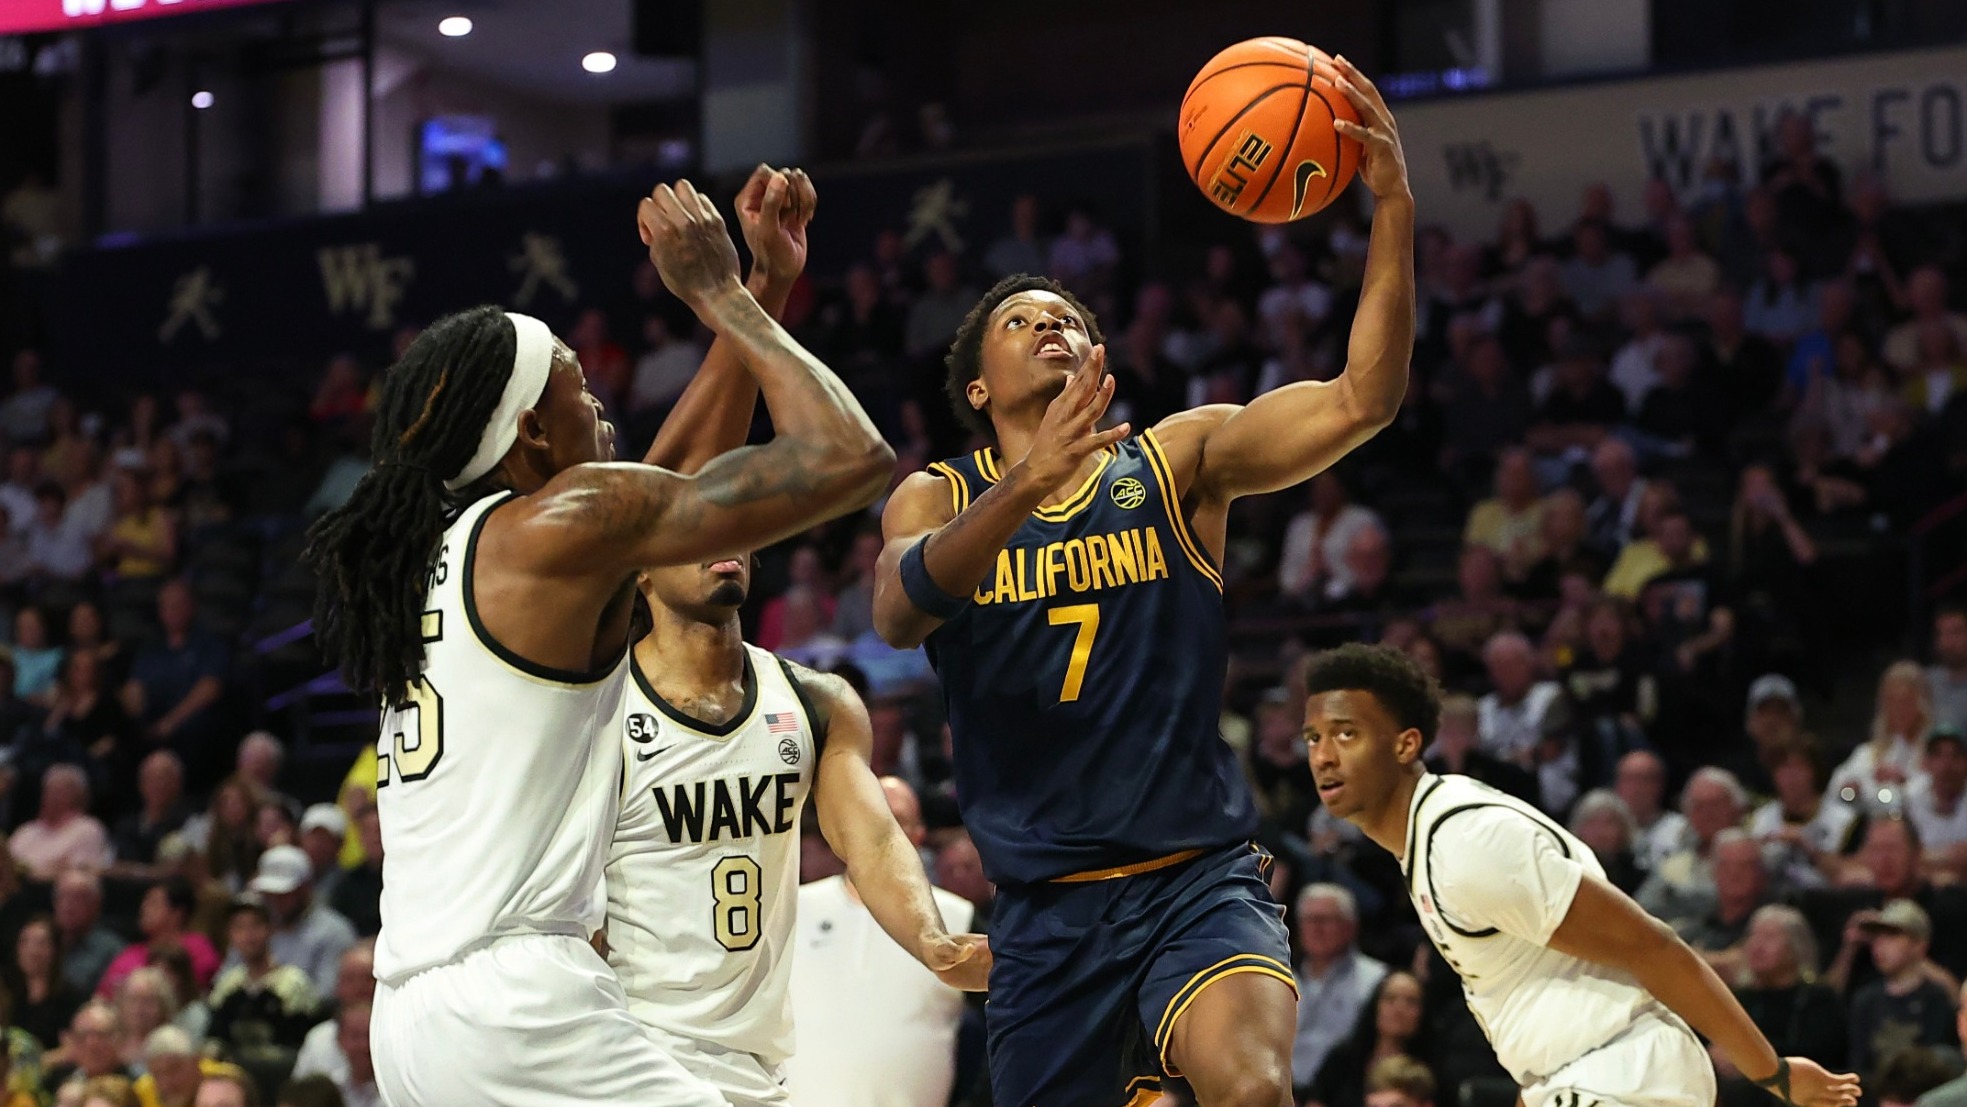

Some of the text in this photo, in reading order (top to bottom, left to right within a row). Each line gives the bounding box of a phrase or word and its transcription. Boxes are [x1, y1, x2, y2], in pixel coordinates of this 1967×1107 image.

[1212, 132, 1273, 209] ELITE
[1047, 603, 1100, 702] 7
[628, 716, 657, 738] 54
[652, 772, 800, 844] WAKE
[711, 855, 762, 952] 8
